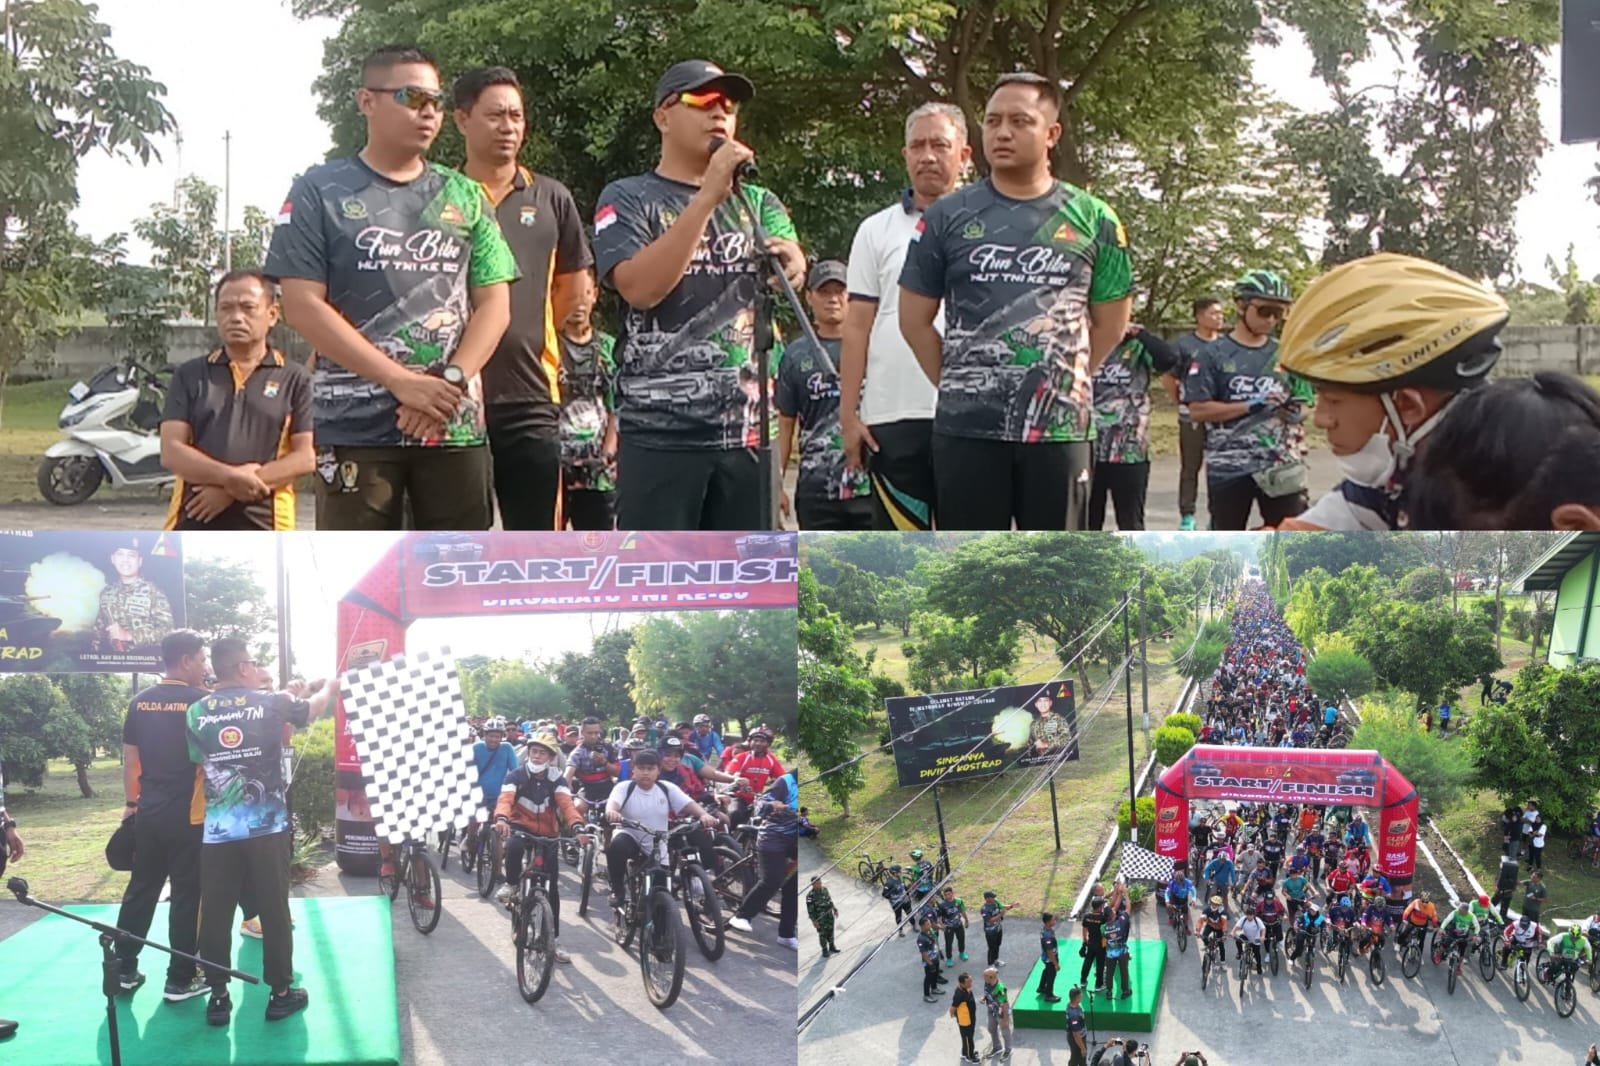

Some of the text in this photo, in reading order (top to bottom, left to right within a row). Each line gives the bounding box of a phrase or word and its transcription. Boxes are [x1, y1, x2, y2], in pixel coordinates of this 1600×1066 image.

[355, 226, 460, 262] Fun Bike
[358, 261, 388, 270] HUT
[969, 244, 1072, 275] Fun Bike
[970, 273, 999, 282] HUT
[1001, 274, 1025, 282] TNI
[137, 702, 187, 712] POLDA JATIM
[245, 705, 264, 720] TNI
[1193, 776, 1375, 797] START/FINISH
